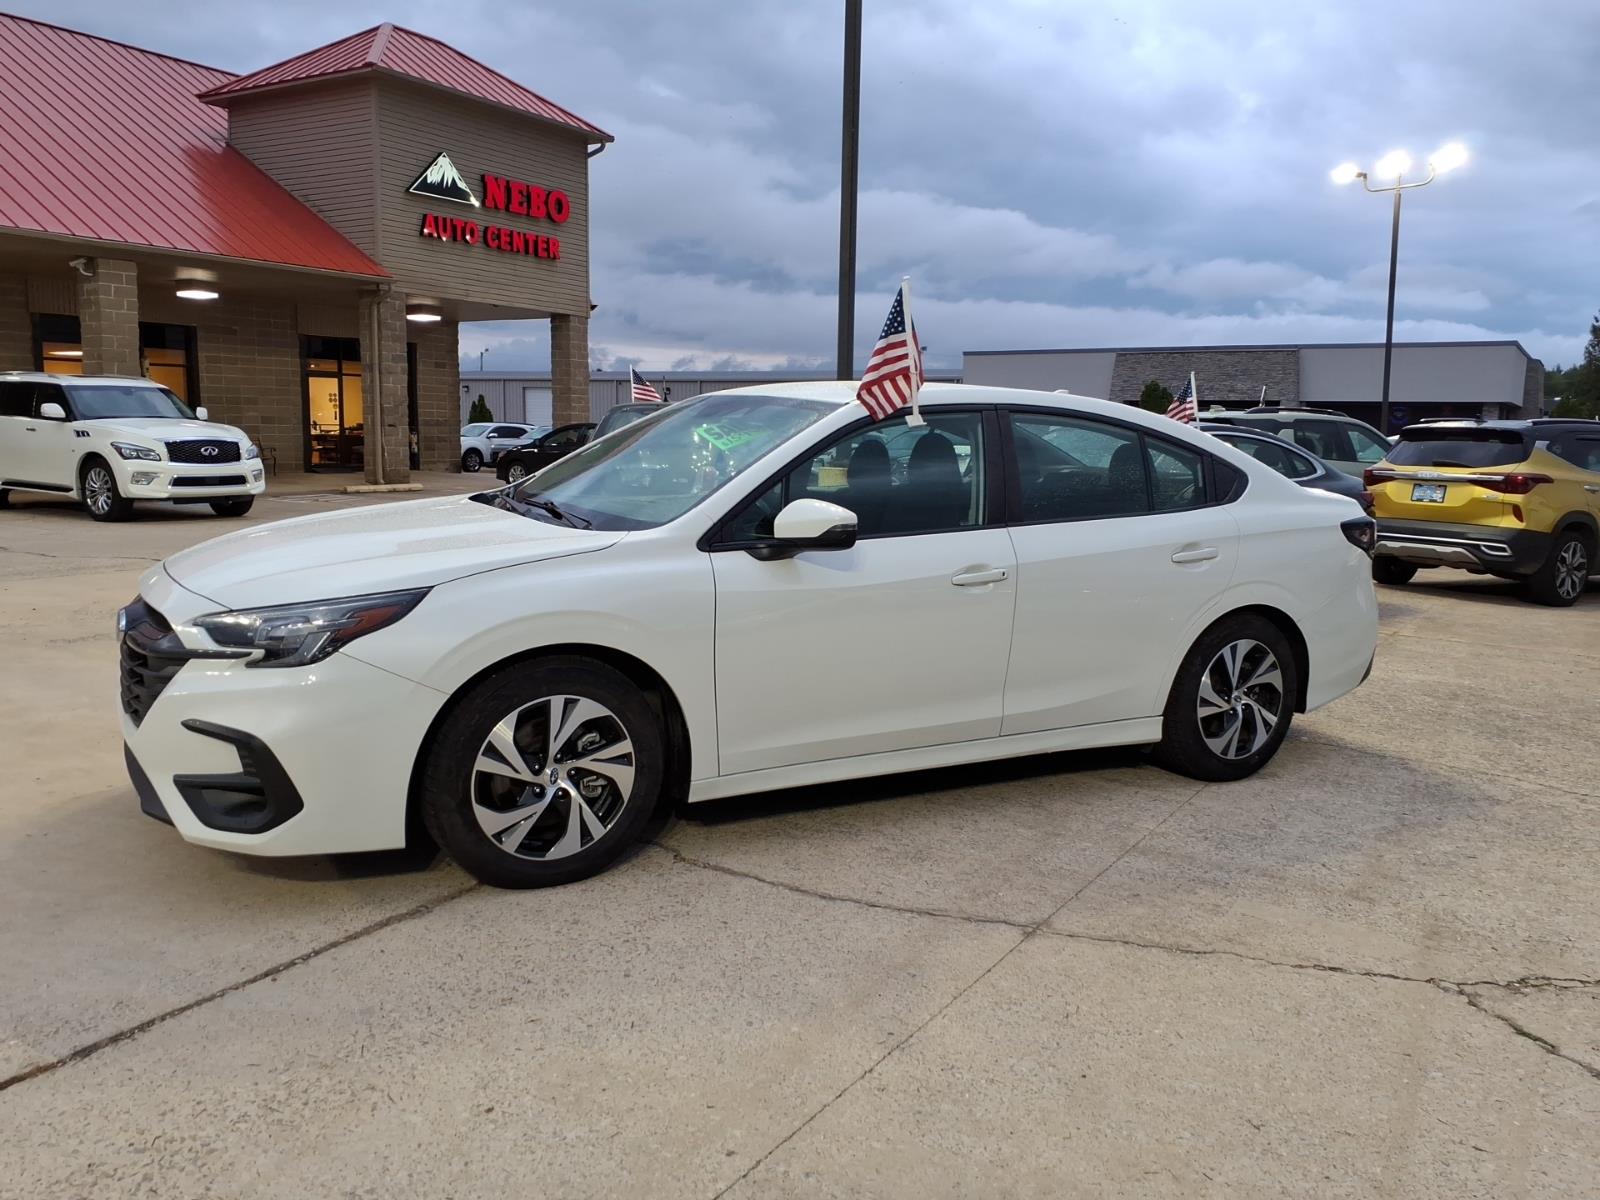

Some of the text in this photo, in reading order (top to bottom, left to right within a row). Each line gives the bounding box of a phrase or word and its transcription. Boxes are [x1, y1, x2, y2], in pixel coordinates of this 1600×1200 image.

[482, 173, 571, 224] NEBO
[422, 212, 561, 260] AUTO CENTER
